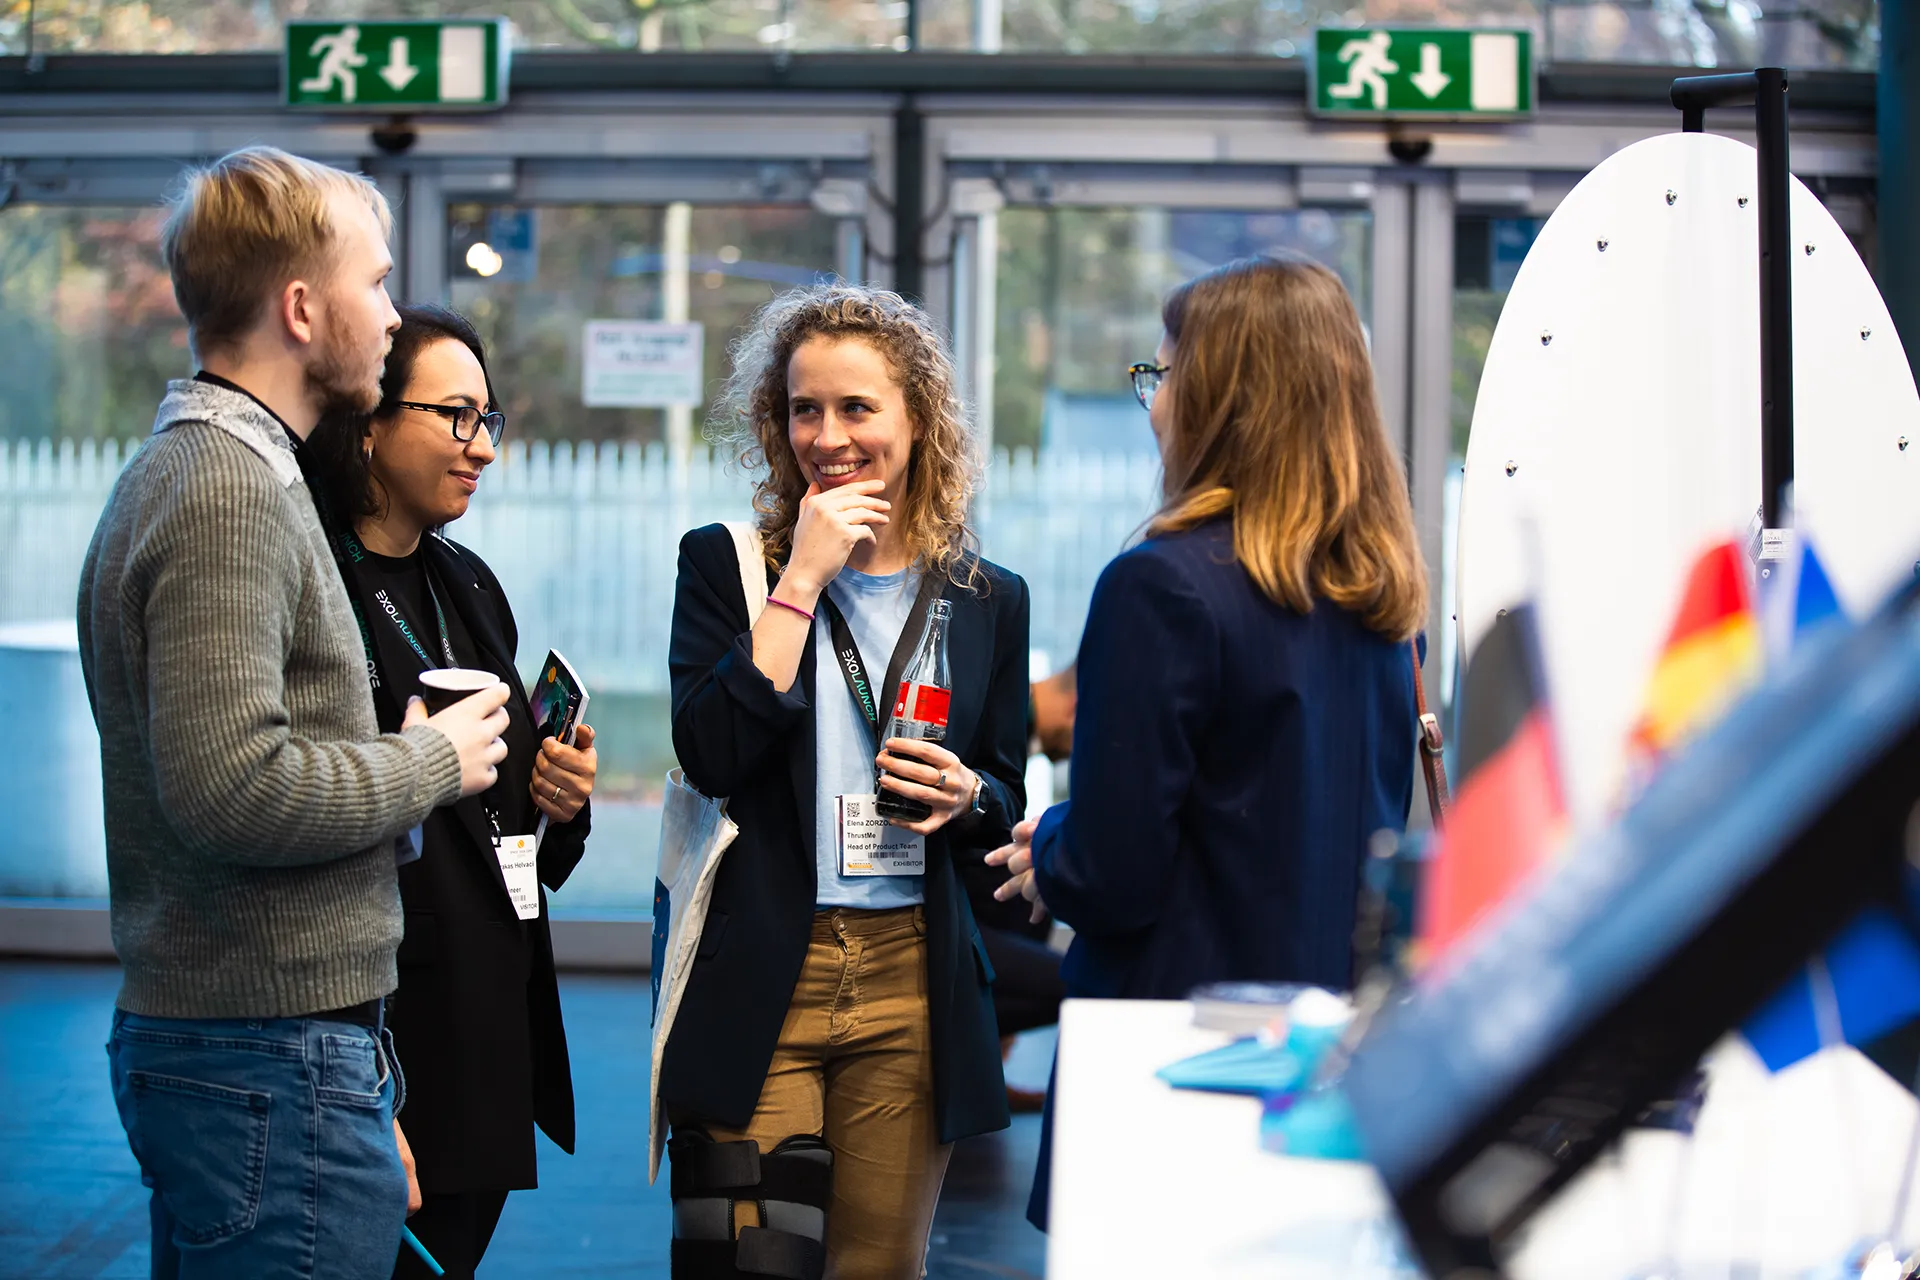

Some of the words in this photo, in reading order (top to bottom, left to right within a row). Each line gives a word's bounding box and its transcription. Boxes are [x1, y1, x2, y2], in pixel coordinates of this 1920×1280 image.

[341, 533, 364, 563] NCH
[375, 589, 427, 659] EXOLAUNCH
[841, 648, 877, 722] EXOLAUNCH
